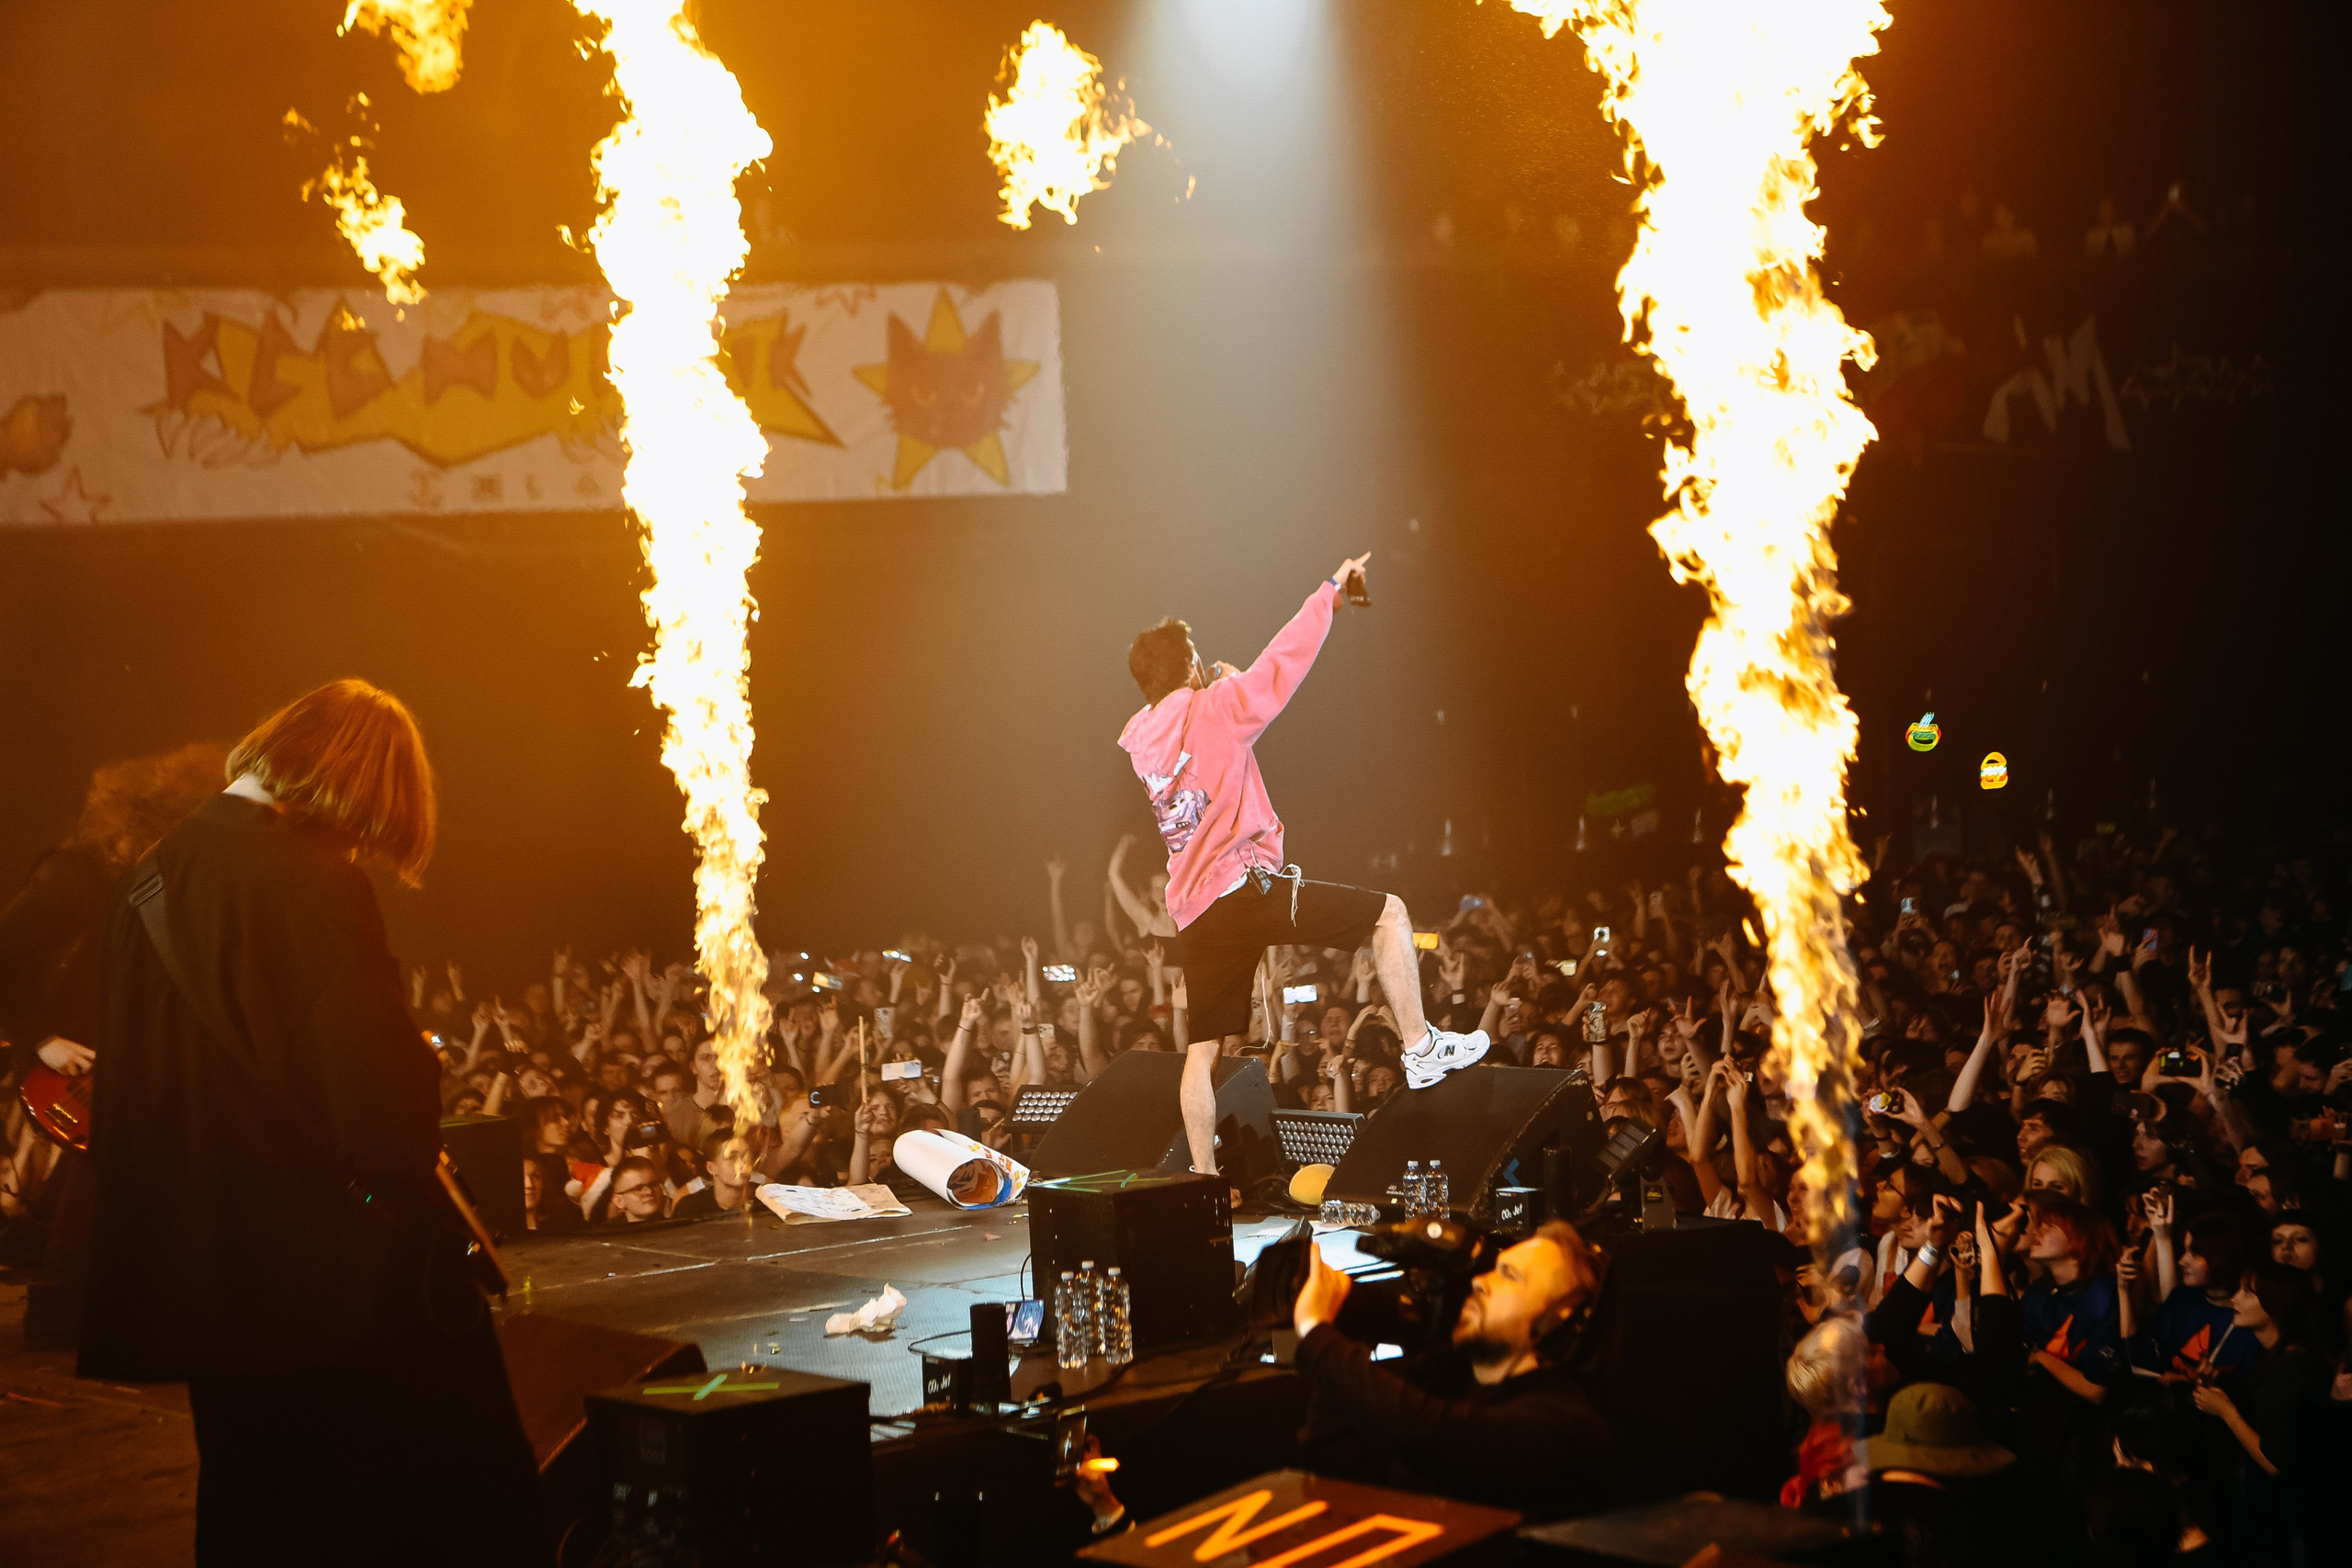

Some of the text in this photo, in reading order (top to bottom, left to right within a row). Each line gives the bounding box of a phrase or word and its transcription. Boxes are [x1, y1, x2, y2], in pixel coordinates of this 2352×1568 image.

[1443, 1044, 1456, 1056] N
[1512, 1202, 1523, 1216] Jet
[940, 1371, 951, 1390] Jet
